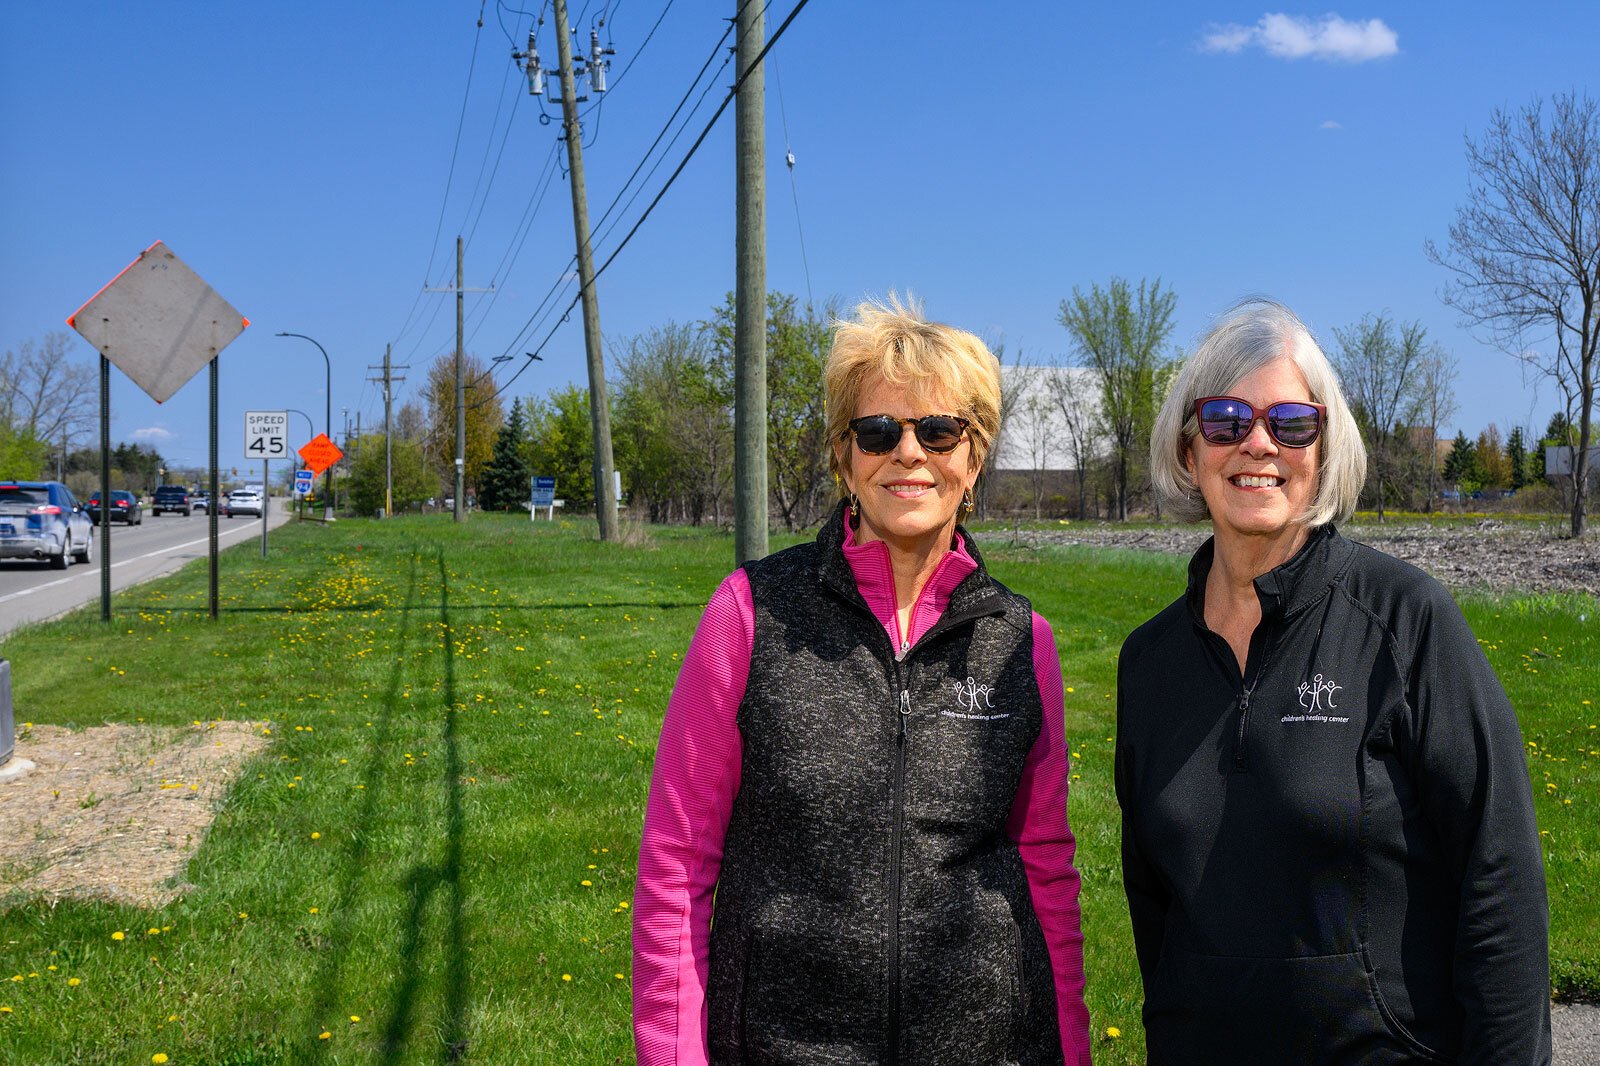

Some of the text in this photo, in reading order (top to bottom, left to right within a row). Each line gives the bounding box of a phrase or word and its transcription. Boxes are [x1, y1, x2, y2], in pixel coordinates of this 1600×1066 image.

[249, 416, 284, 424] SPEED
[249, 437, 283, 453] 45
[297, 482, 308, 490] 94
[941, 709, 966, 719] children's
[967, 713, 989, 721] healing
[1281, 714, 1305, 722] children's
[1306, 713, 1327, 723] healing
